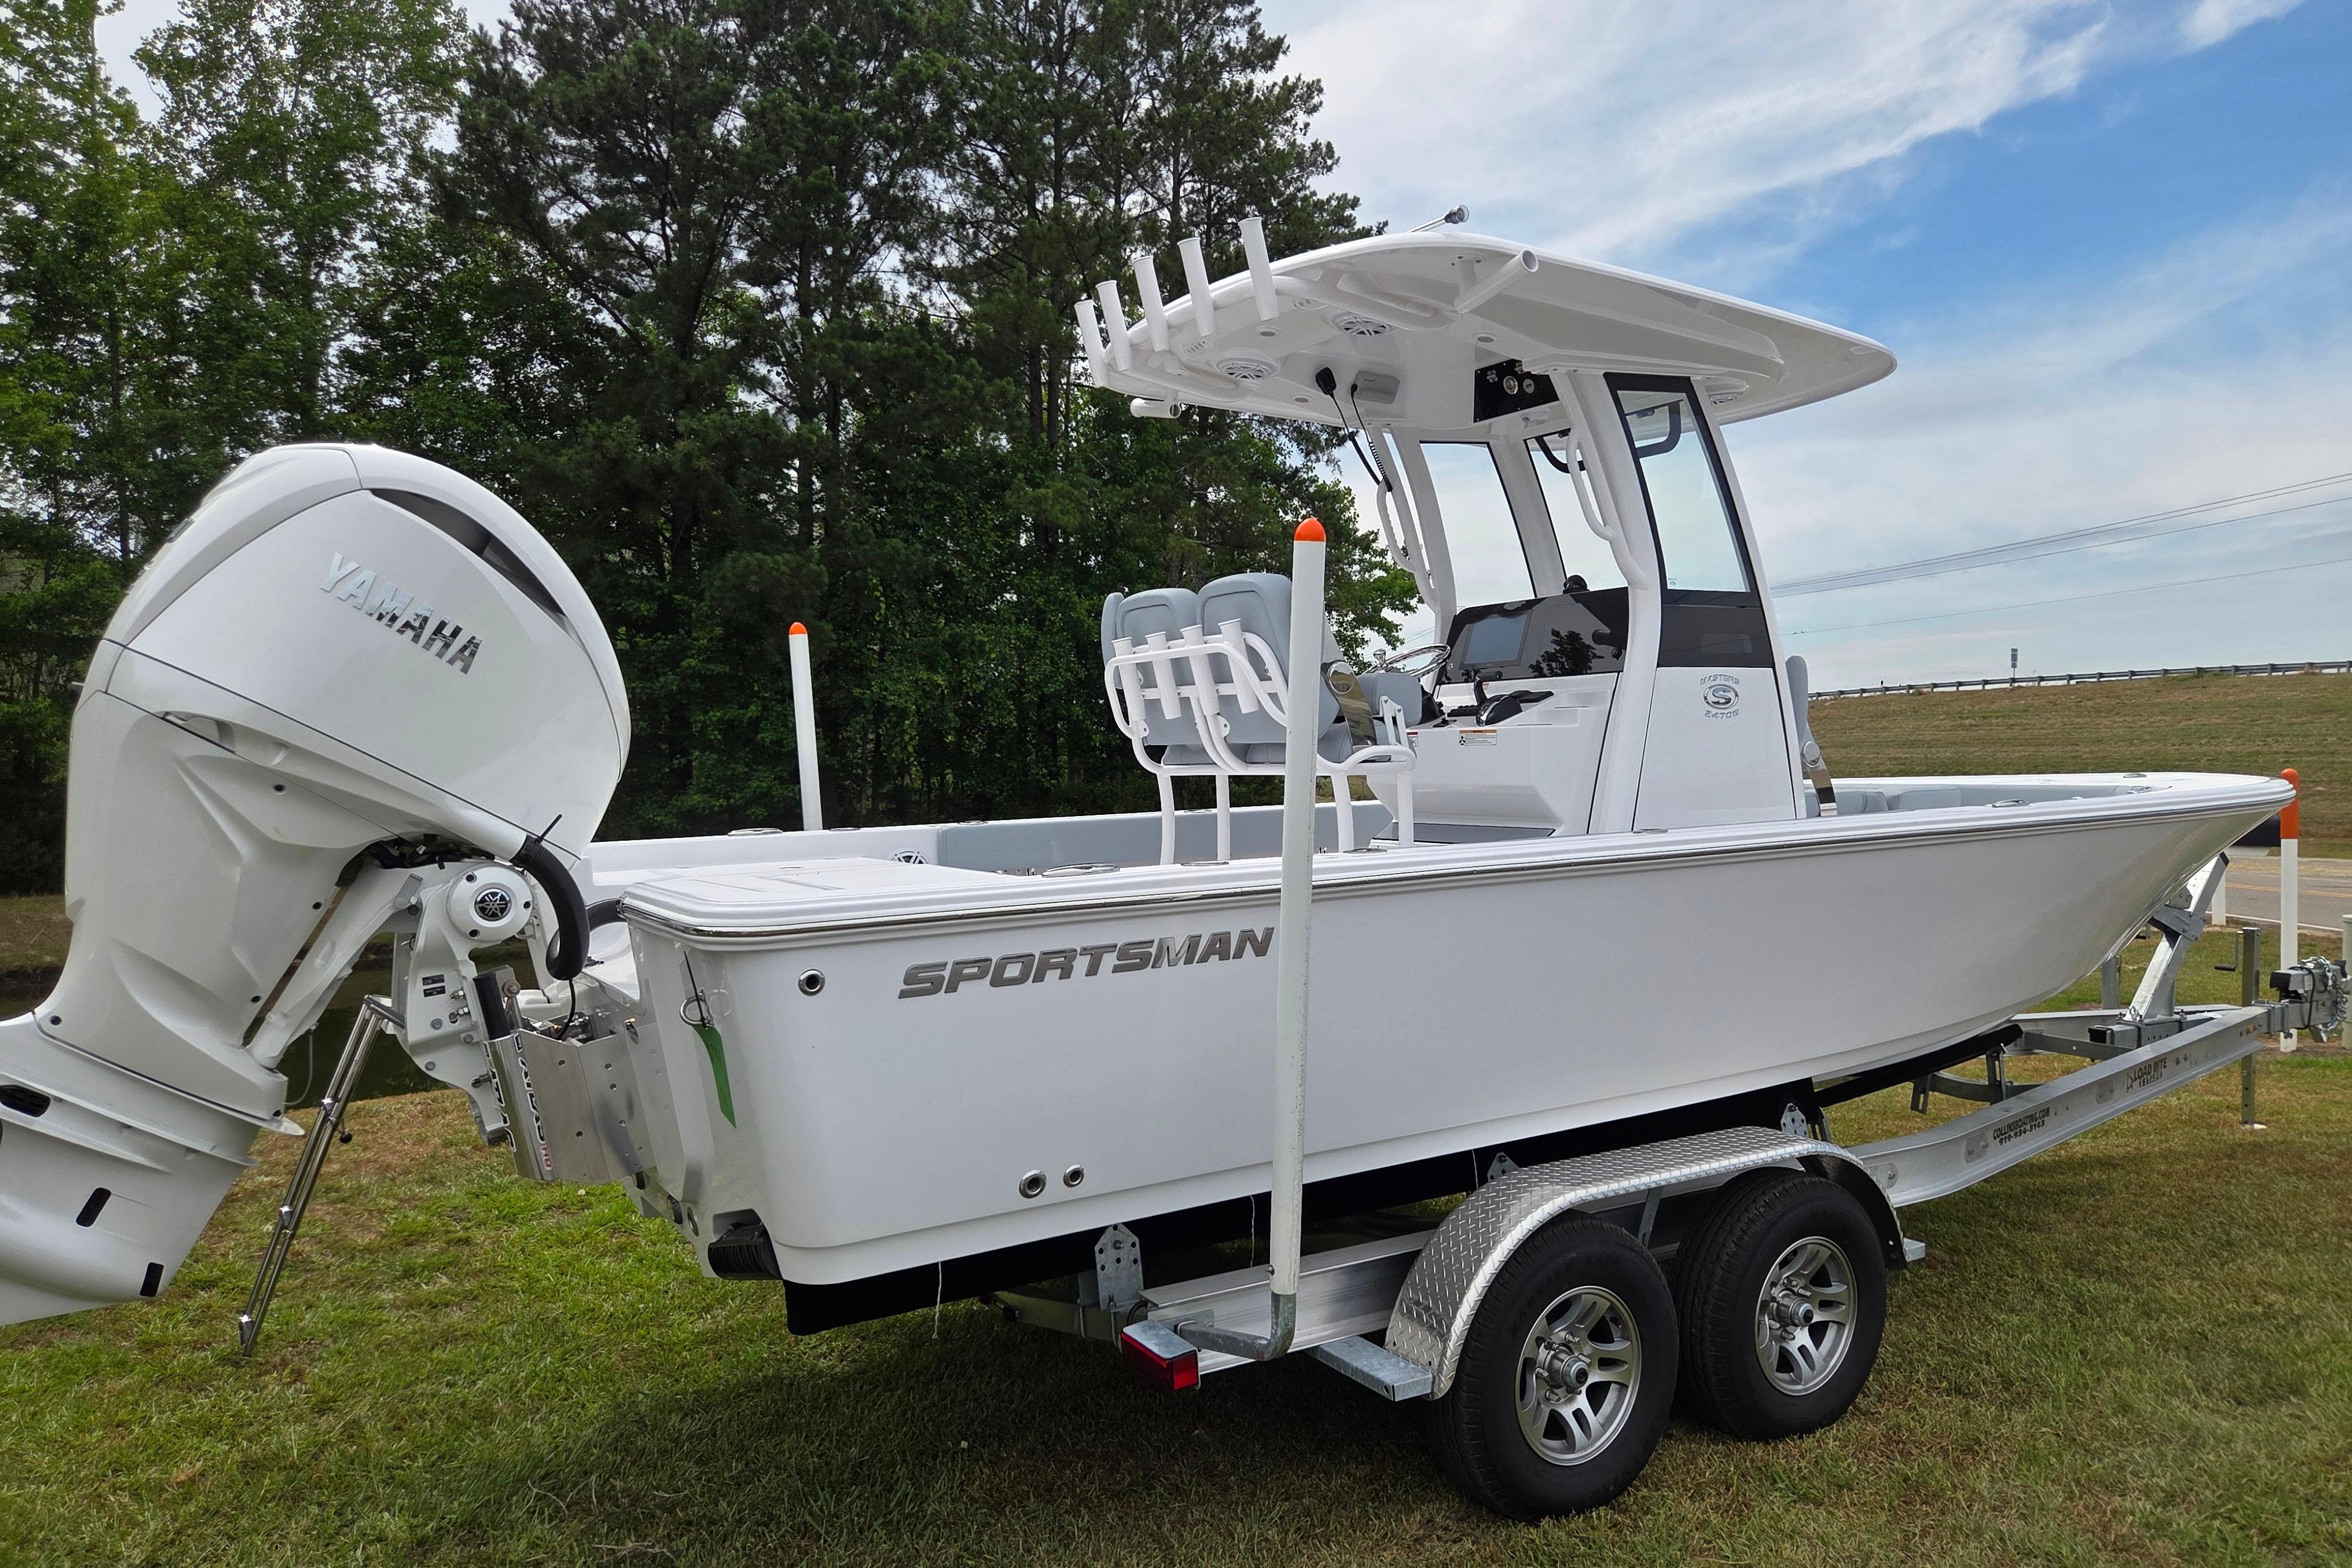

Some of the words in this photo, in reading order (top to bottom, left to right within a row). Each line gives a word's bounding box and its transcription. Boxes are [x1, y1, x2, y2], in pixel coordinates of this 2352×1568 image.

[320, 553, 483, 675] YAMAHA
[897, 927, 1275, 999] SPORTSMAN
[2133, 1062, 2152, 1082] LOAD
[2153, 1057, 2167, 1073] RITE
[1993, 1106, 2050, 1141] COLLINSBOATING.COM
